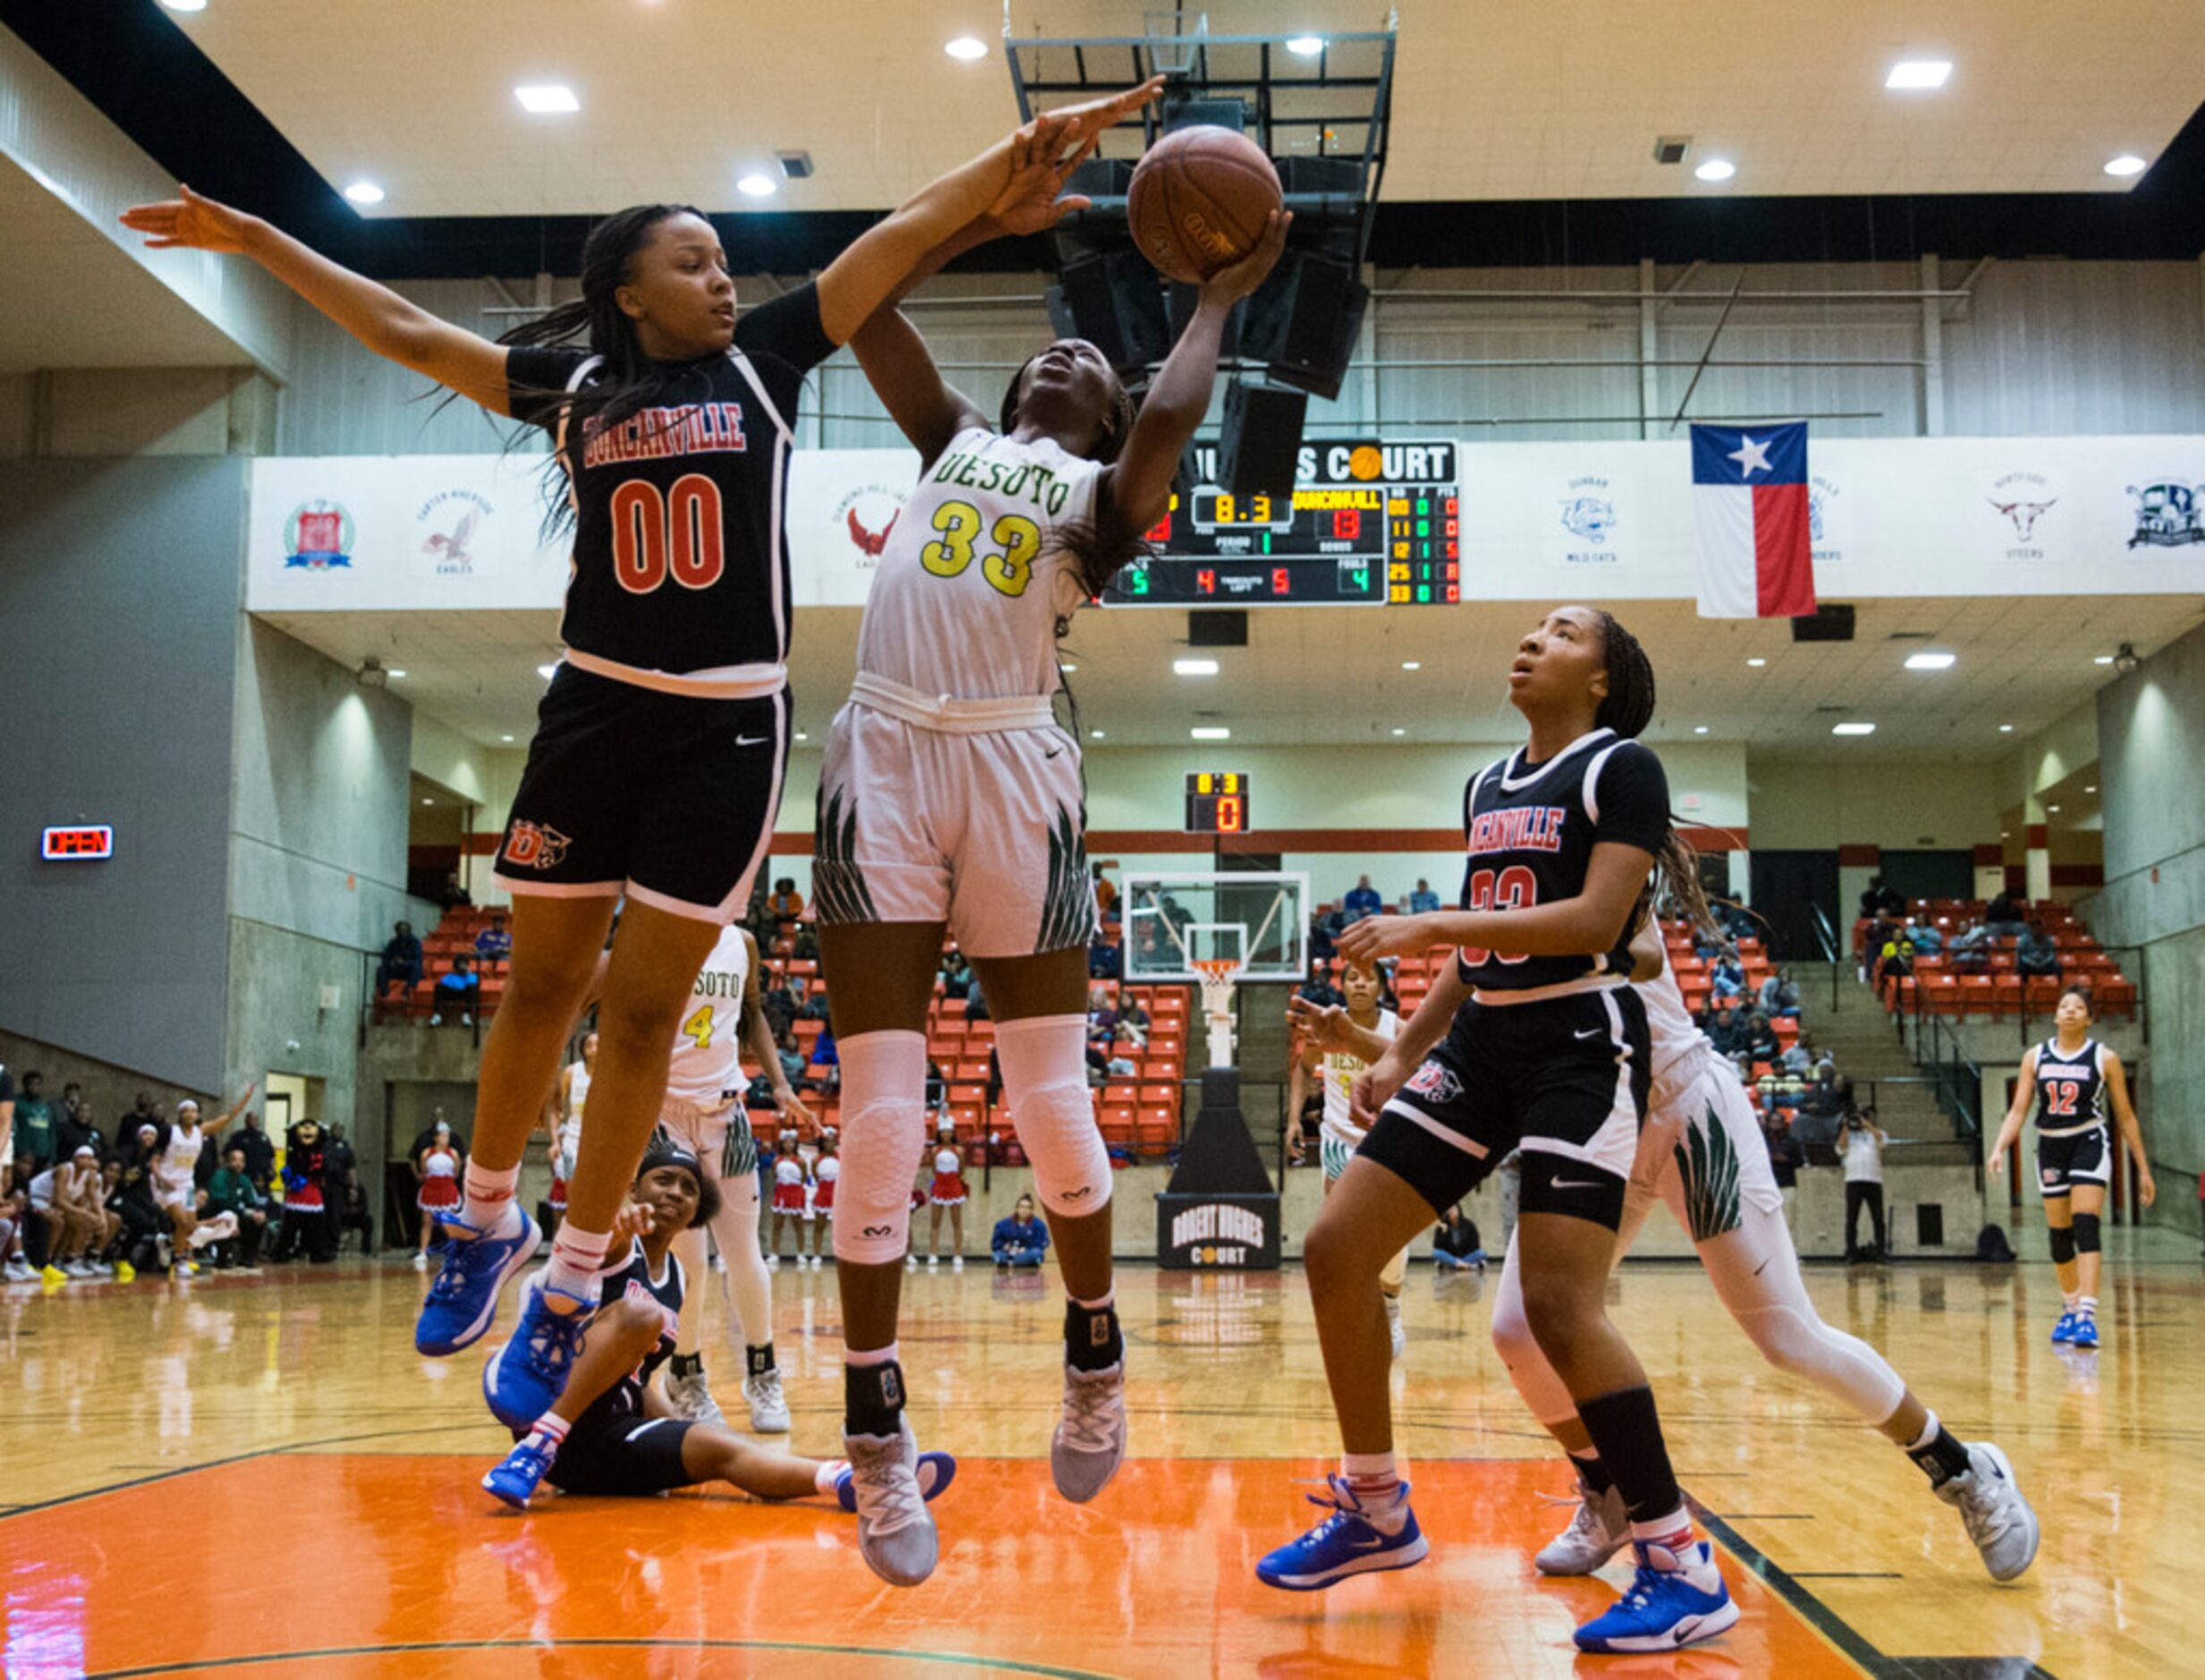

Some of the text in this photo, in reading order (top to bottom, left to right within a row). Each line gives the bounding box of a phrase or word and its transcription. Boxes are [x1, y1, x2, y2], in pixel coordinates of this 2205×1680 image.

[933, 454, 1070, 516] DESOTO
[1216, 495, 1270, 522] 8.3
[612, 473, 725, 594] 00
[1262, 531, 1271, 555] 1
[921, 499, 1045, 598] 33
[1132, 569, 1149, 594] 5
[1197, 569, 1214, 593] 4
[1273, 568, 1289, 593] 5
[1353, 568, 1368, 591] 4
[1217, 795, 1241, 833] 0
[47, 830, 108, 854] OPEN
[683, 1005, 715, 1049] 4
[2046, 1080, 2079, 1115] 12
[1191, 1246, 1247, 1264] COURT
